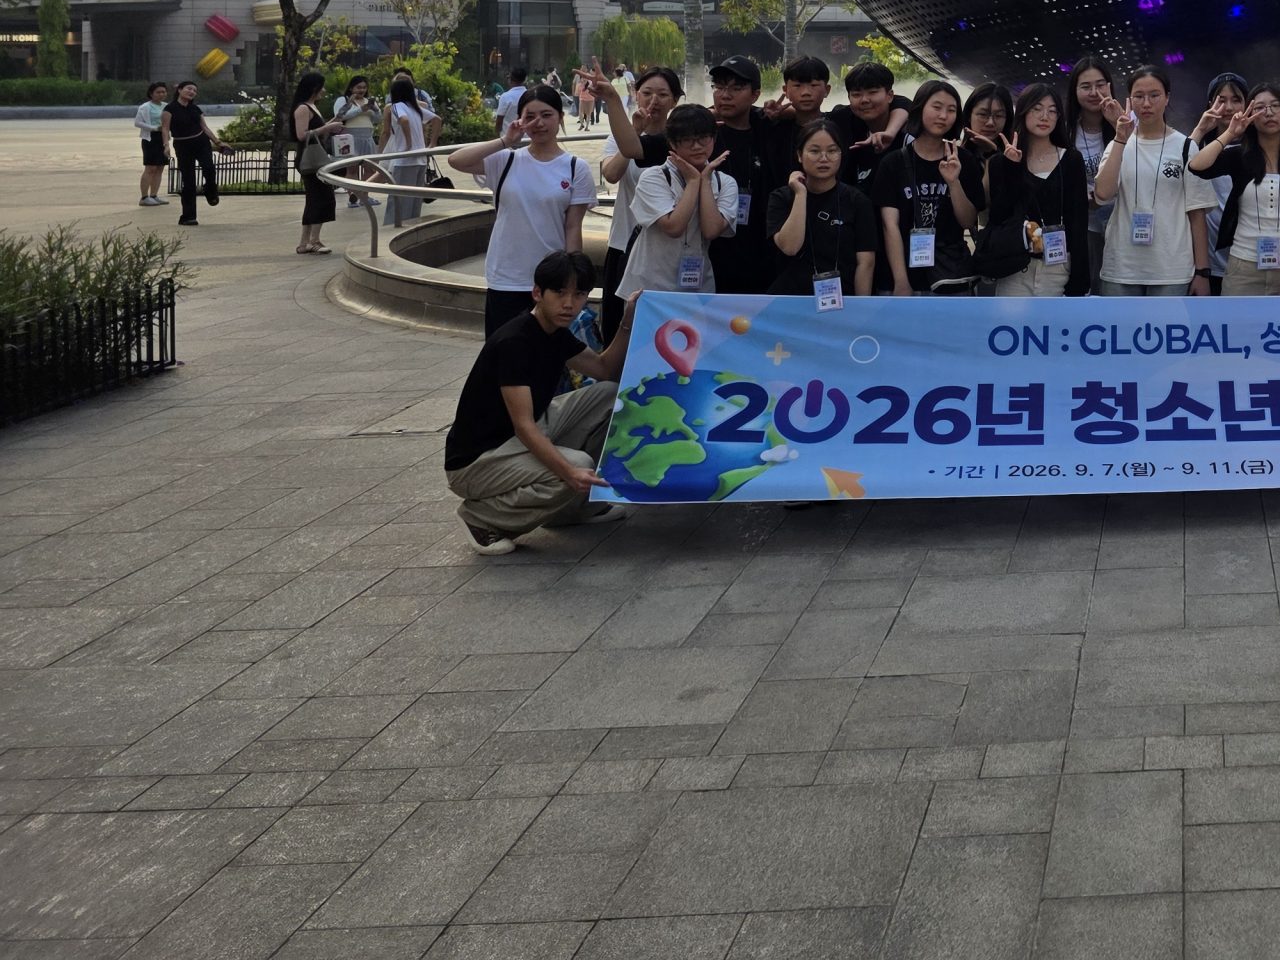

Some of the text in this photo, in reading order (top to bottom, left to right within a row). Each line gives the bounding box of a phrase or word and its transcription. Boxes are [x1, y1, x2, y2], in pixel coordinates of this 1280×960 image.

[988, 325, 1050, 356] ON
[706, 378, 1045, 446] 2026년
[945, 465, 985, 480] 기간
[1008, 464, 1066, 478] 2026.
[1075, 463, 1094, 477] 9.
[1182, 462, 1200, 475] 9.
